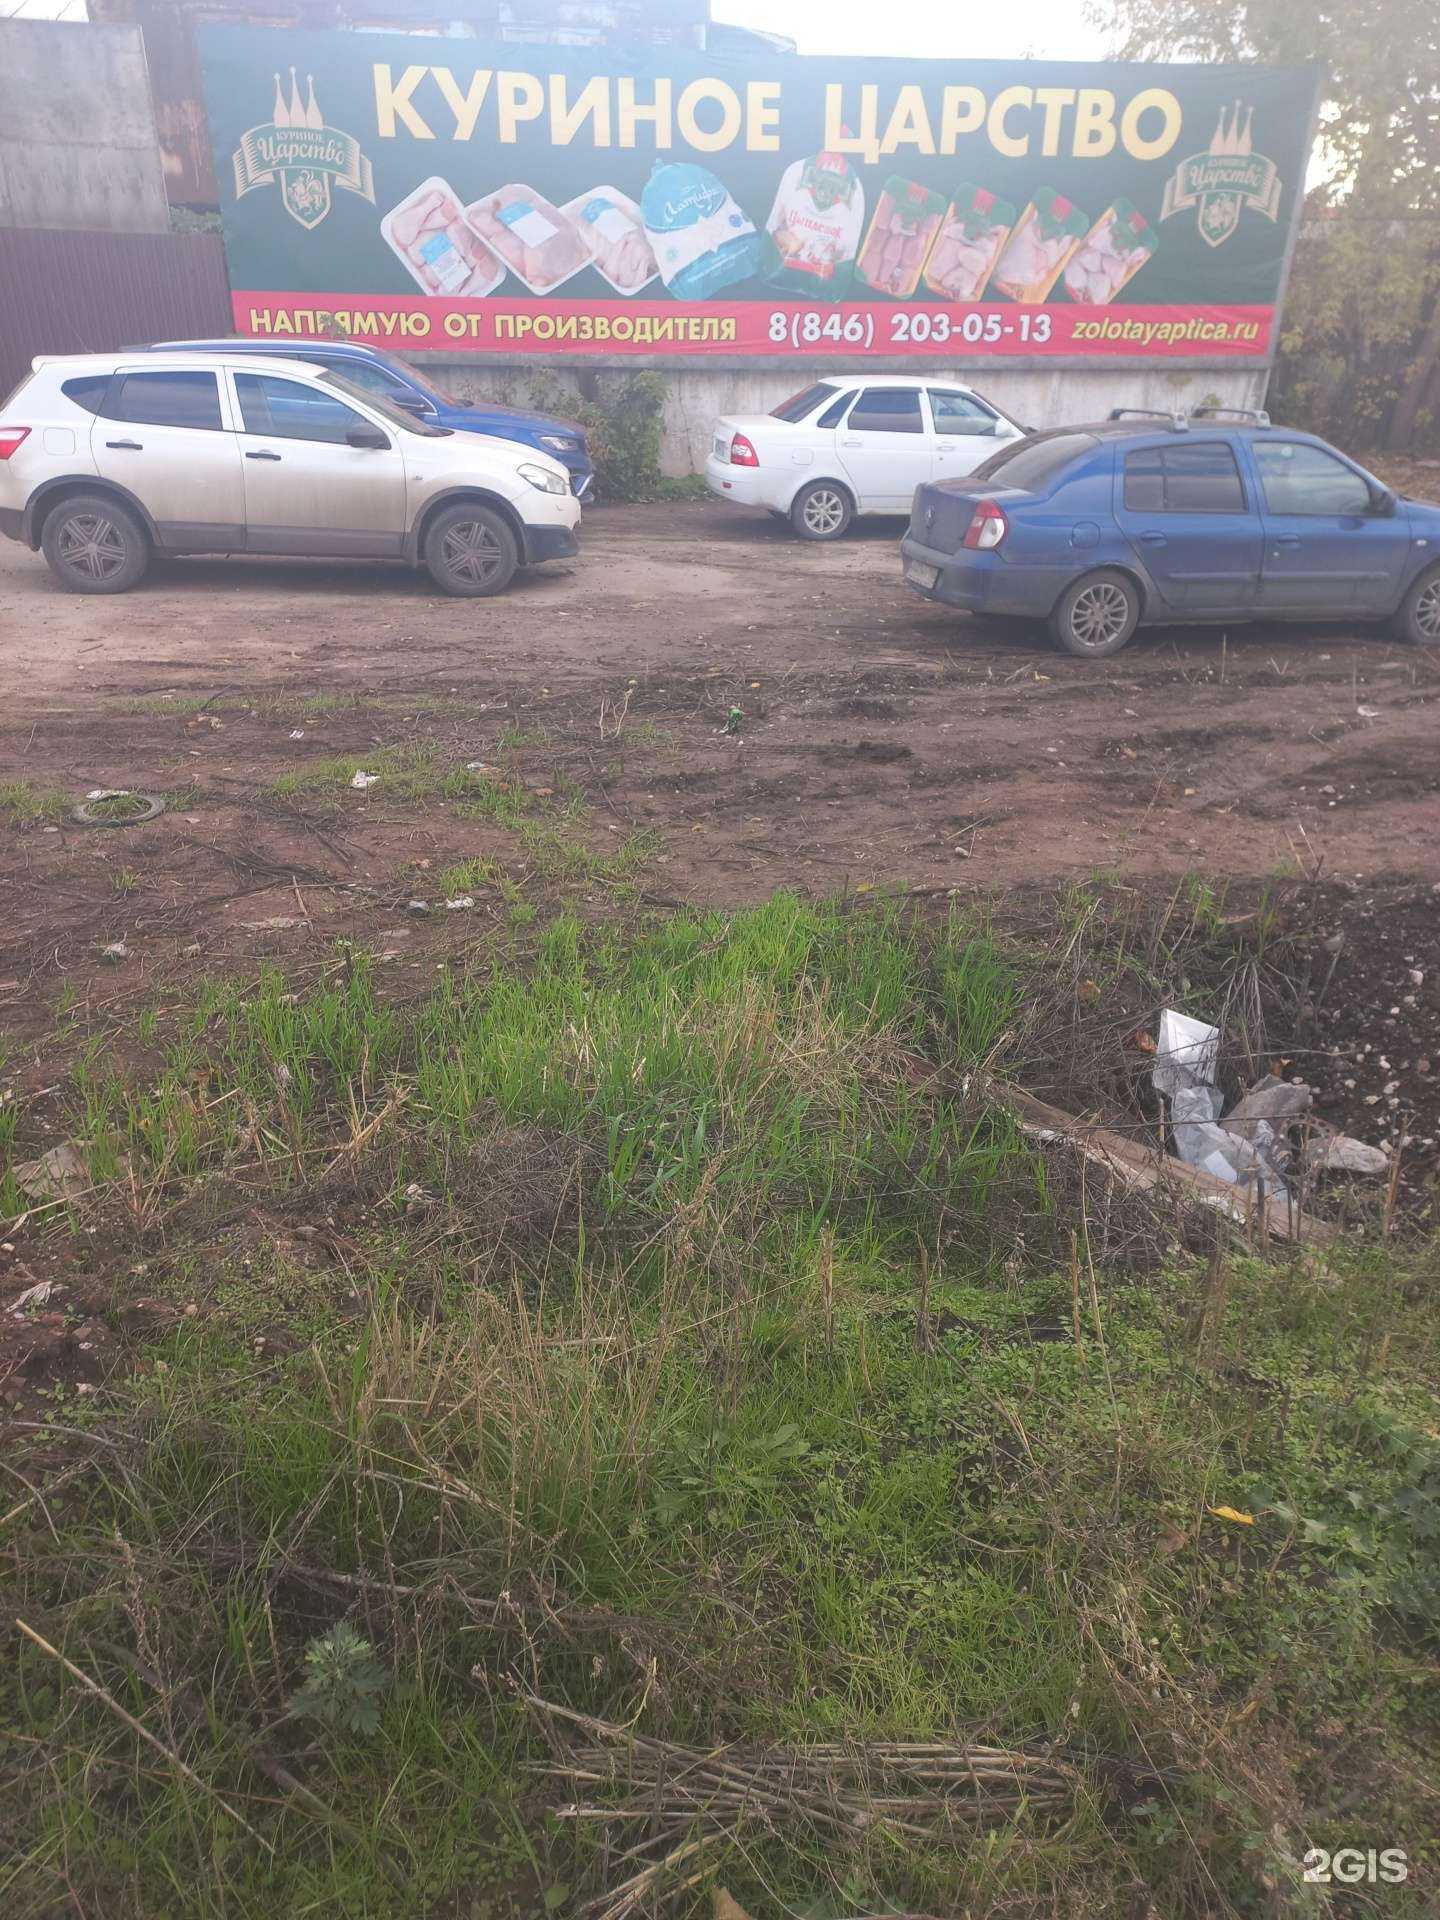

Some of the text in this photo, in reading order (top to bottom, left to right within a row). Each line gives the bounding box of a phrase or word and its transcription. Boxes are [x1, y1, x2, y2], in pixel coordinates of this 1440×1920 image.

[373, 63, 1182, 164] КУРИНОЕ ЦАРСТВО
[256, 137, 345, 166] Царство
[443, 312, 482, 338] ОТ
[494, 314, 737, 343] ПРОИЗВОДИТЕЛЯ
[768, 312, 1052, 348] 8(846) 203-05-13
[1071, 317, 1260, 346] zolotayaptica.ru
